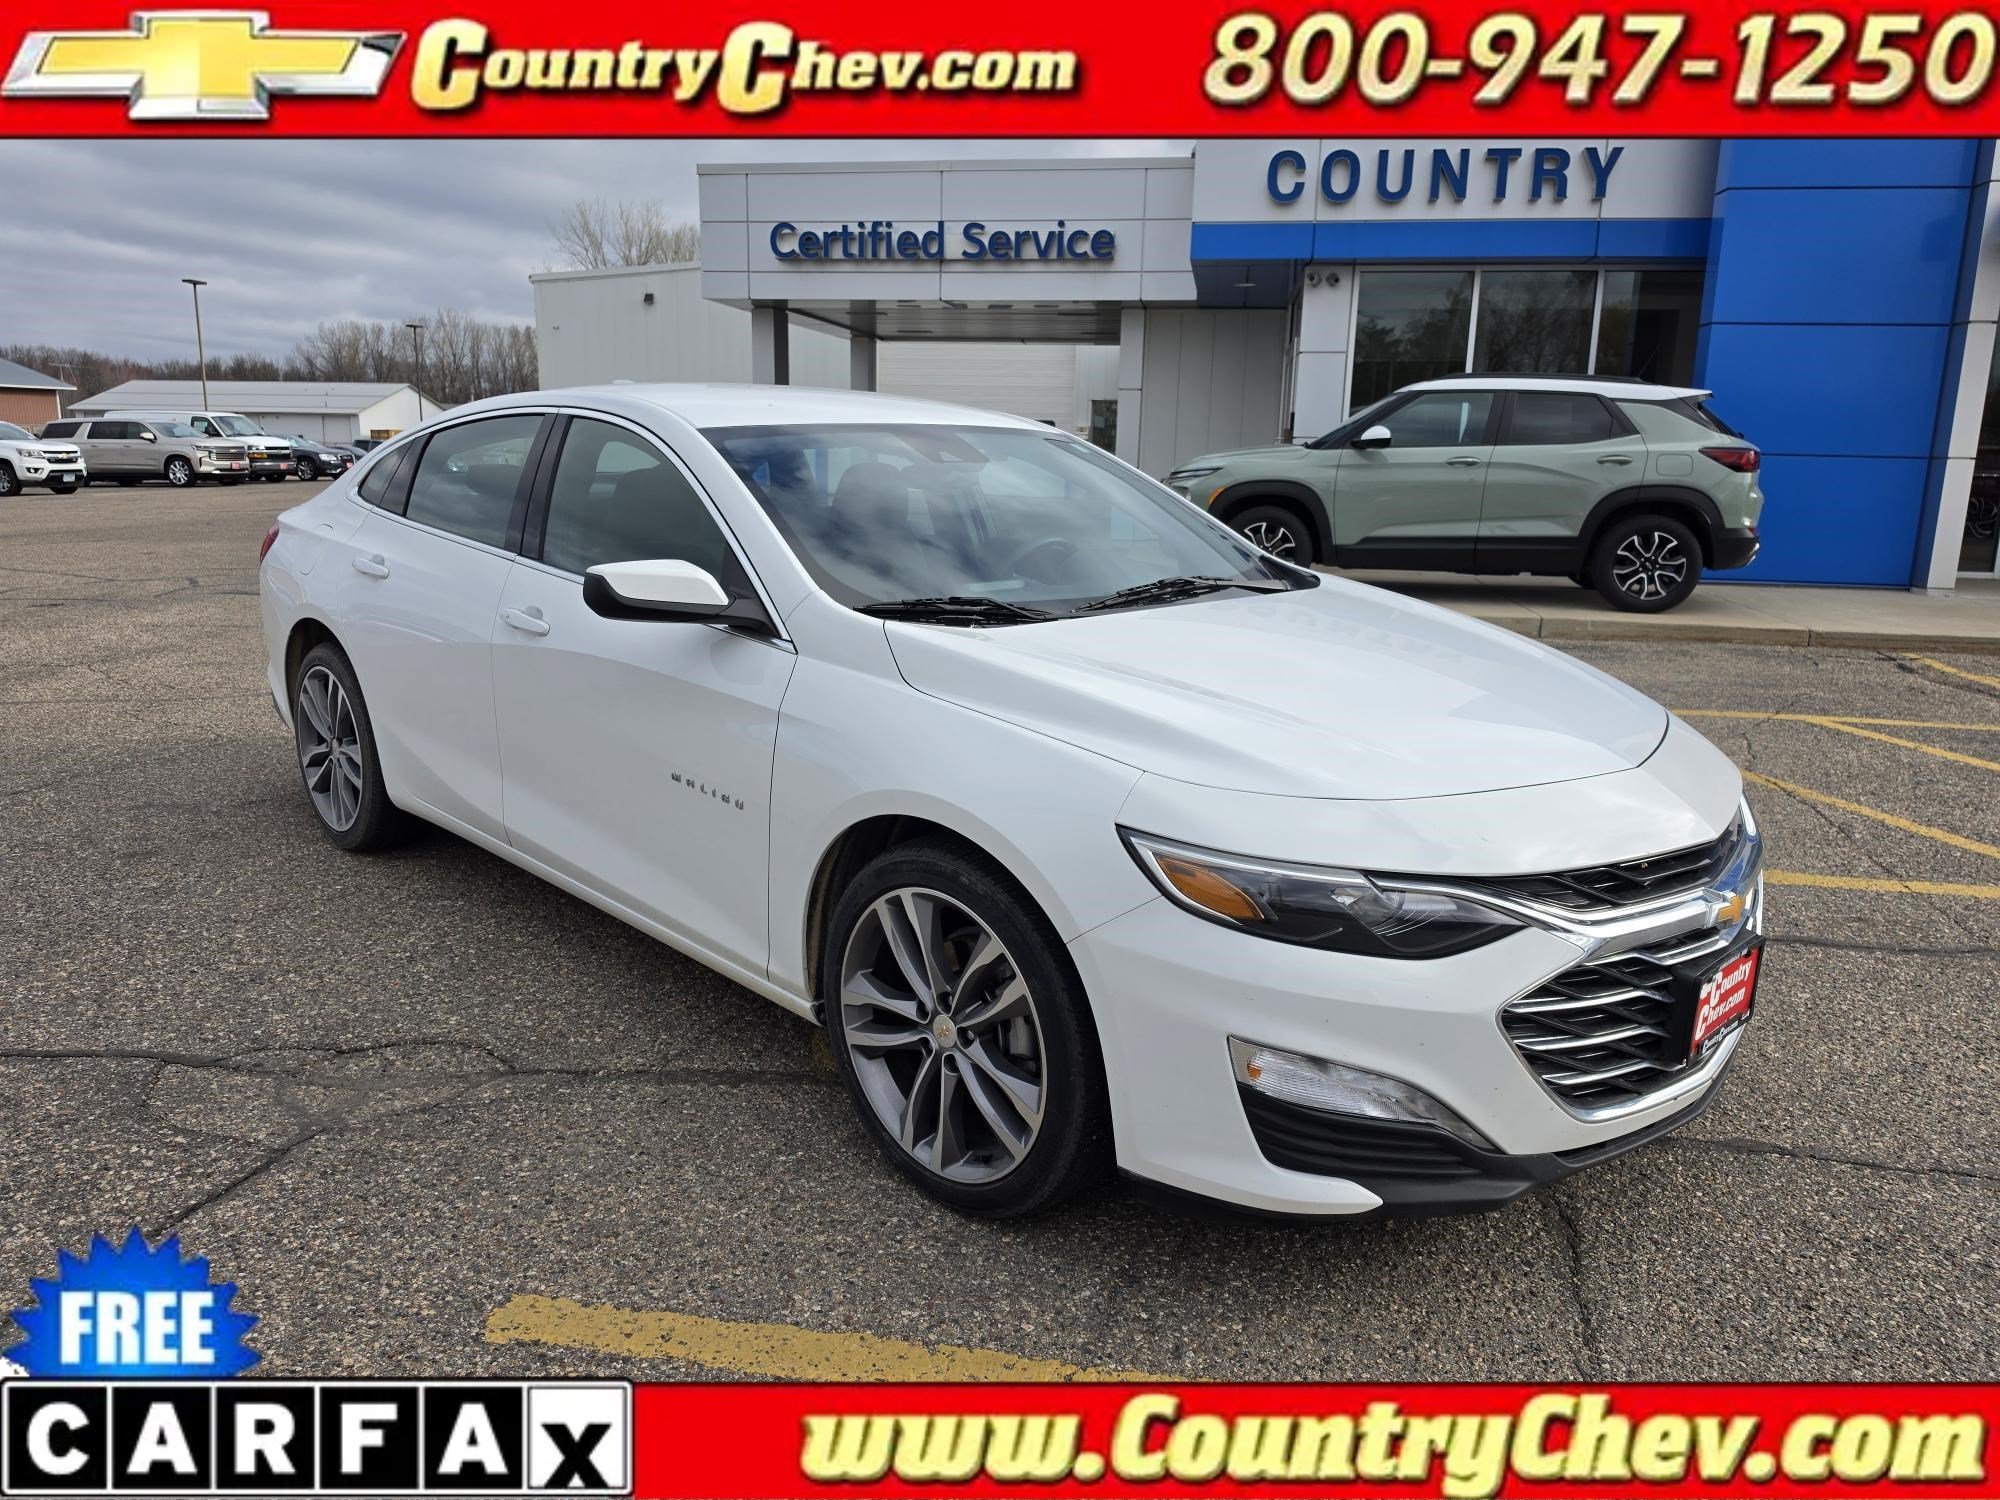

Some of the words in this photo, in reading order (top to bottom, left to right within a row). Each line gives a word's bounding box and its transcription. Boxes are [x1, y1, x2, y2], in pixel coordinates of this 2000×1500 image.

[1266, 145, 1626, 206] COUNTRY
[769, 220, 945, 262] Certified
[961, 221, 1117, 262] Service
[1709, 960, 1752, 1006] Country
